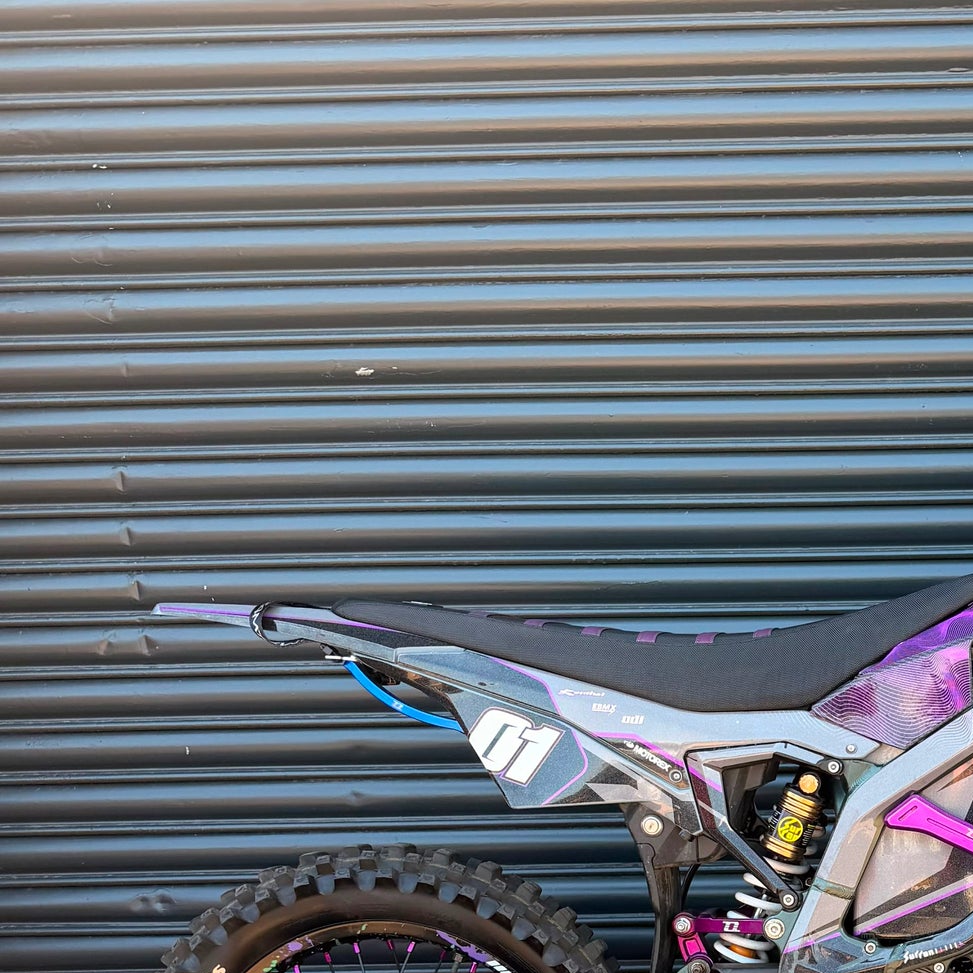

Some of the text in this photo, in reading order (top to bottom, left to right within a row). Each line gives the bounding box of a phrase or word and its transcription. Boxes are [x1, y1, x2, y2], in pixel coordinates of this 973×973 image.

[592, 702, 617, 715] EBMX
[469, 708, 565, 787] 01
[633, 744, 673, 772] MOTOREX
